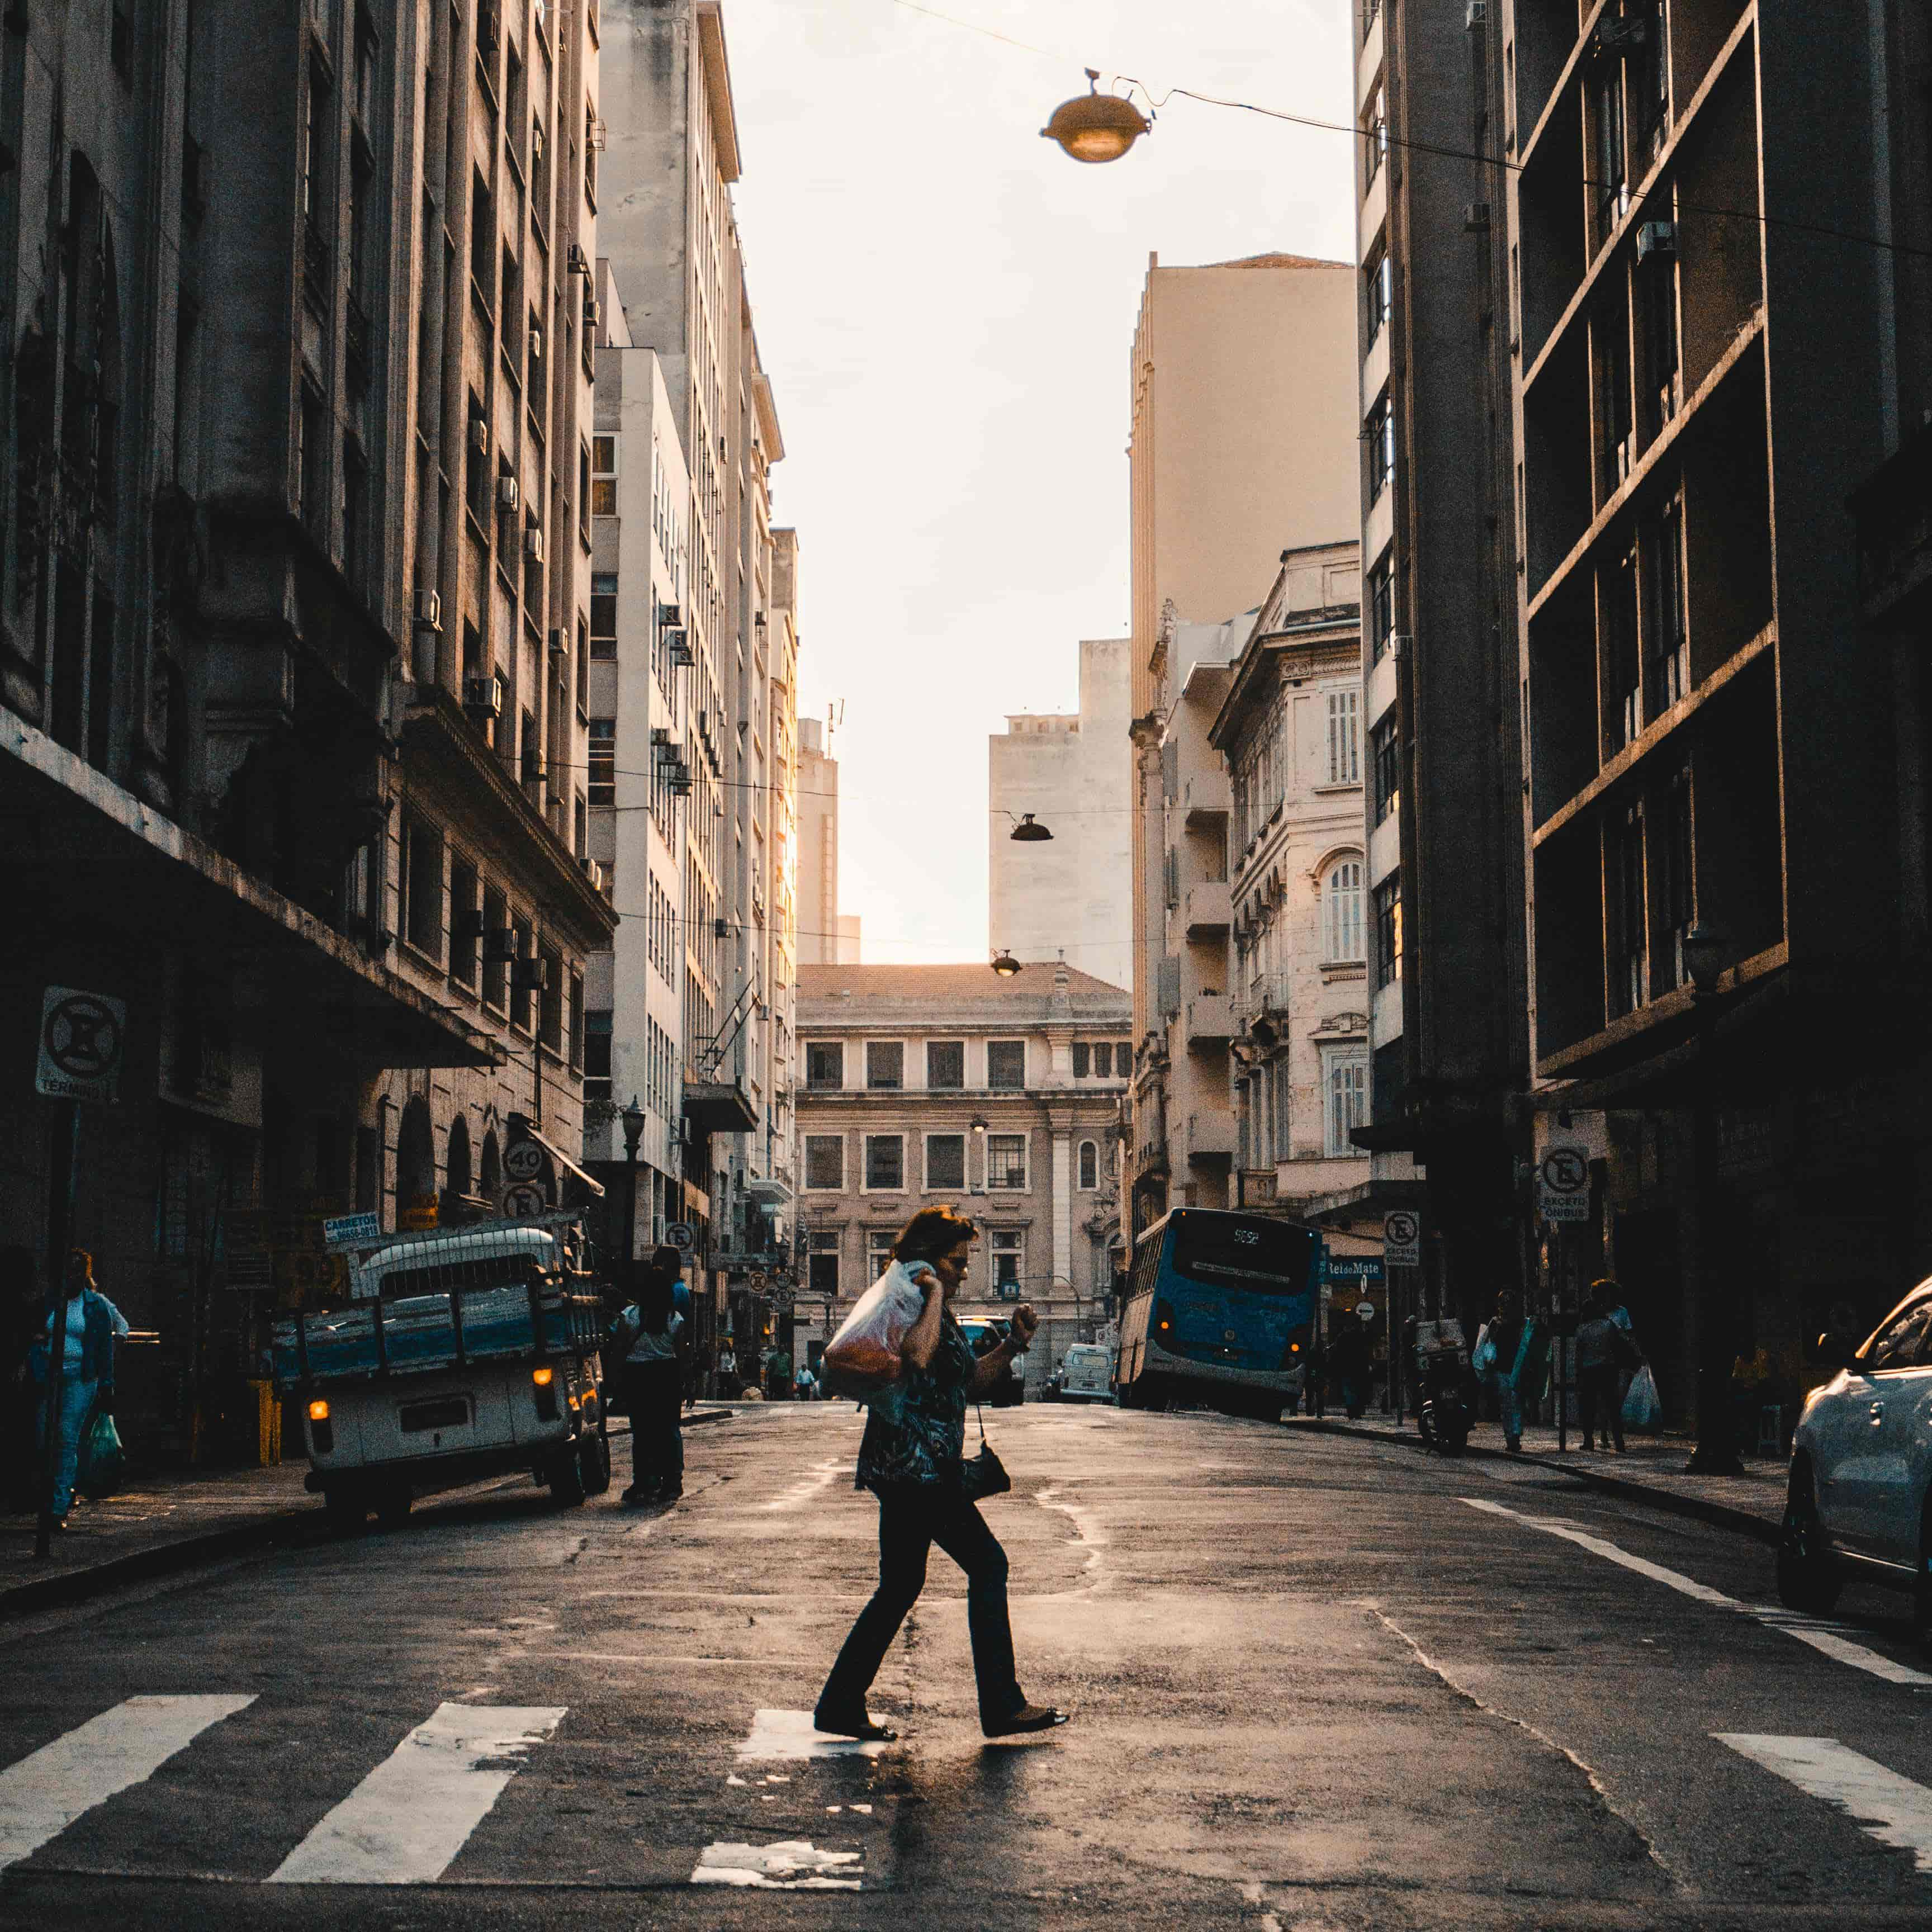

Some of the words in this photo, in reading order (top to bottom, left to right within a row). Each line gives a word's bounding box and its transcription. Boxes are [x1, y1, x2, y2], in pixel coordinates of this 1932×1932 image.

[510, 1150, 539, 1167] 40
[325, 1214, 377, 1232] CARRETOS
[1353, 1262, 1379, 1274] Mate
